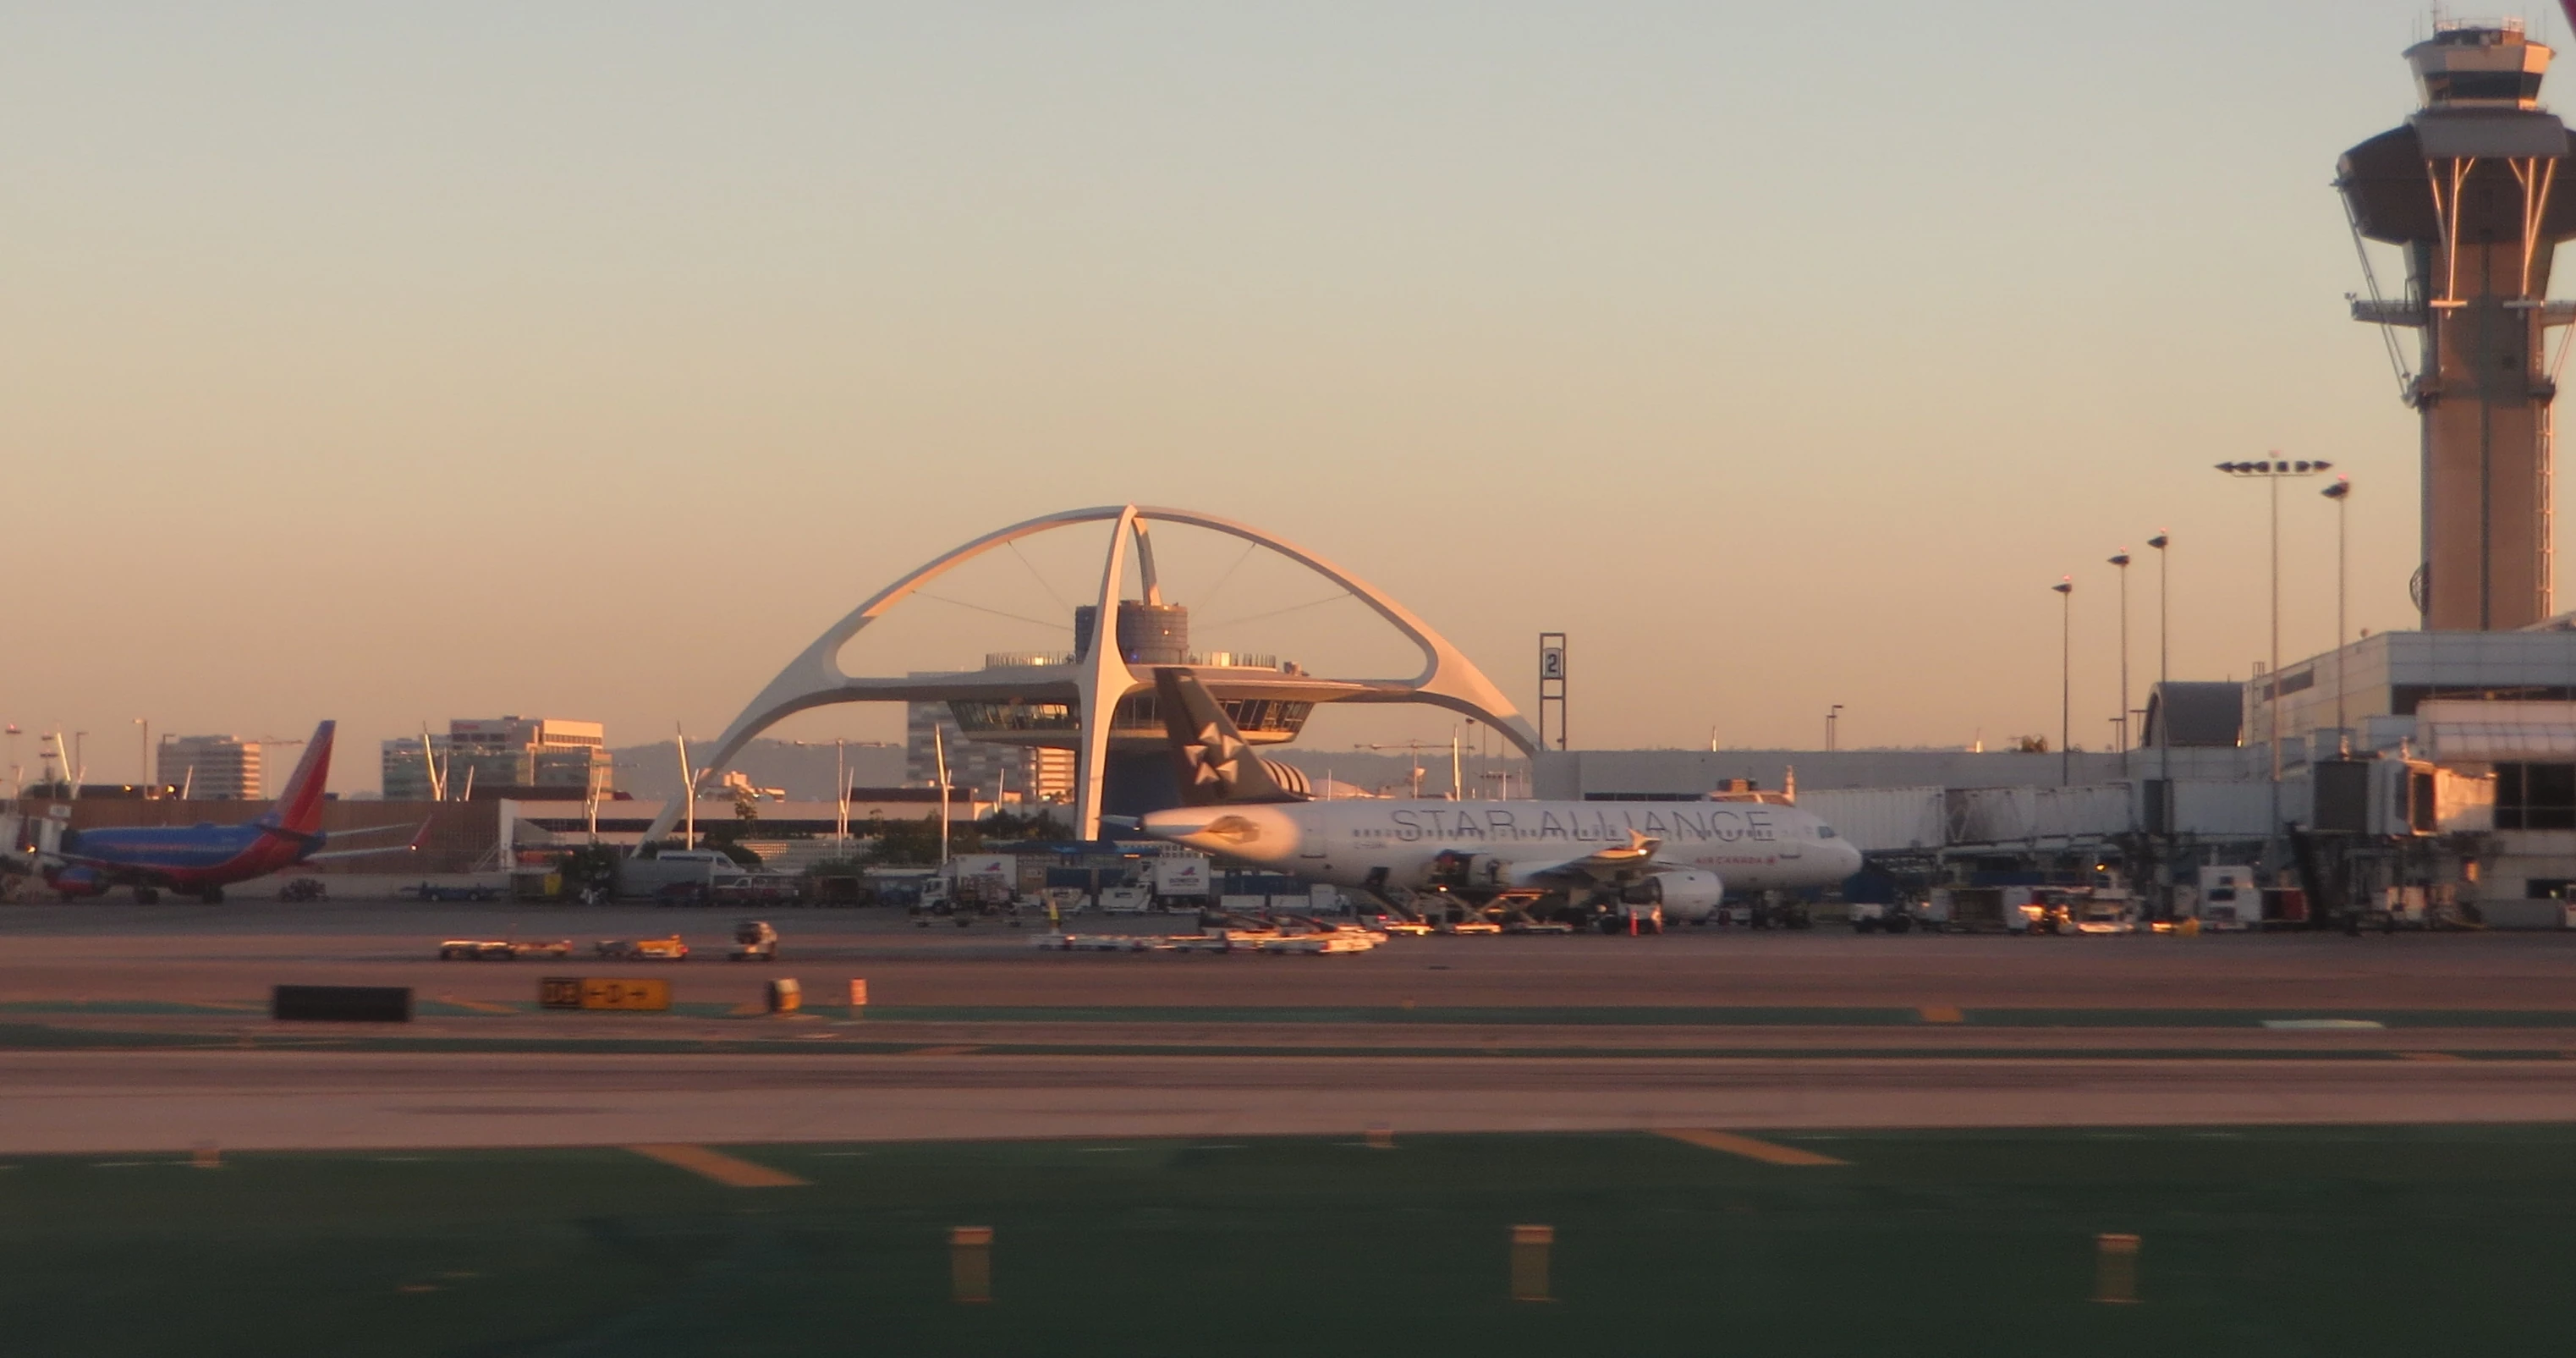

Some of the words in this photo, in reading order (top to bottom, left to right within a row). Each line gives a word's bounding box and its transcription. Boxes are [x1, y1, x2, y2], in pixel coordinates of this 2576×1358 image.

[1547, 652, 1558, 674] 2
[1391, 809, 1519, 842] STAR
[1540, 809, 1776, 843] ALLIANCE
